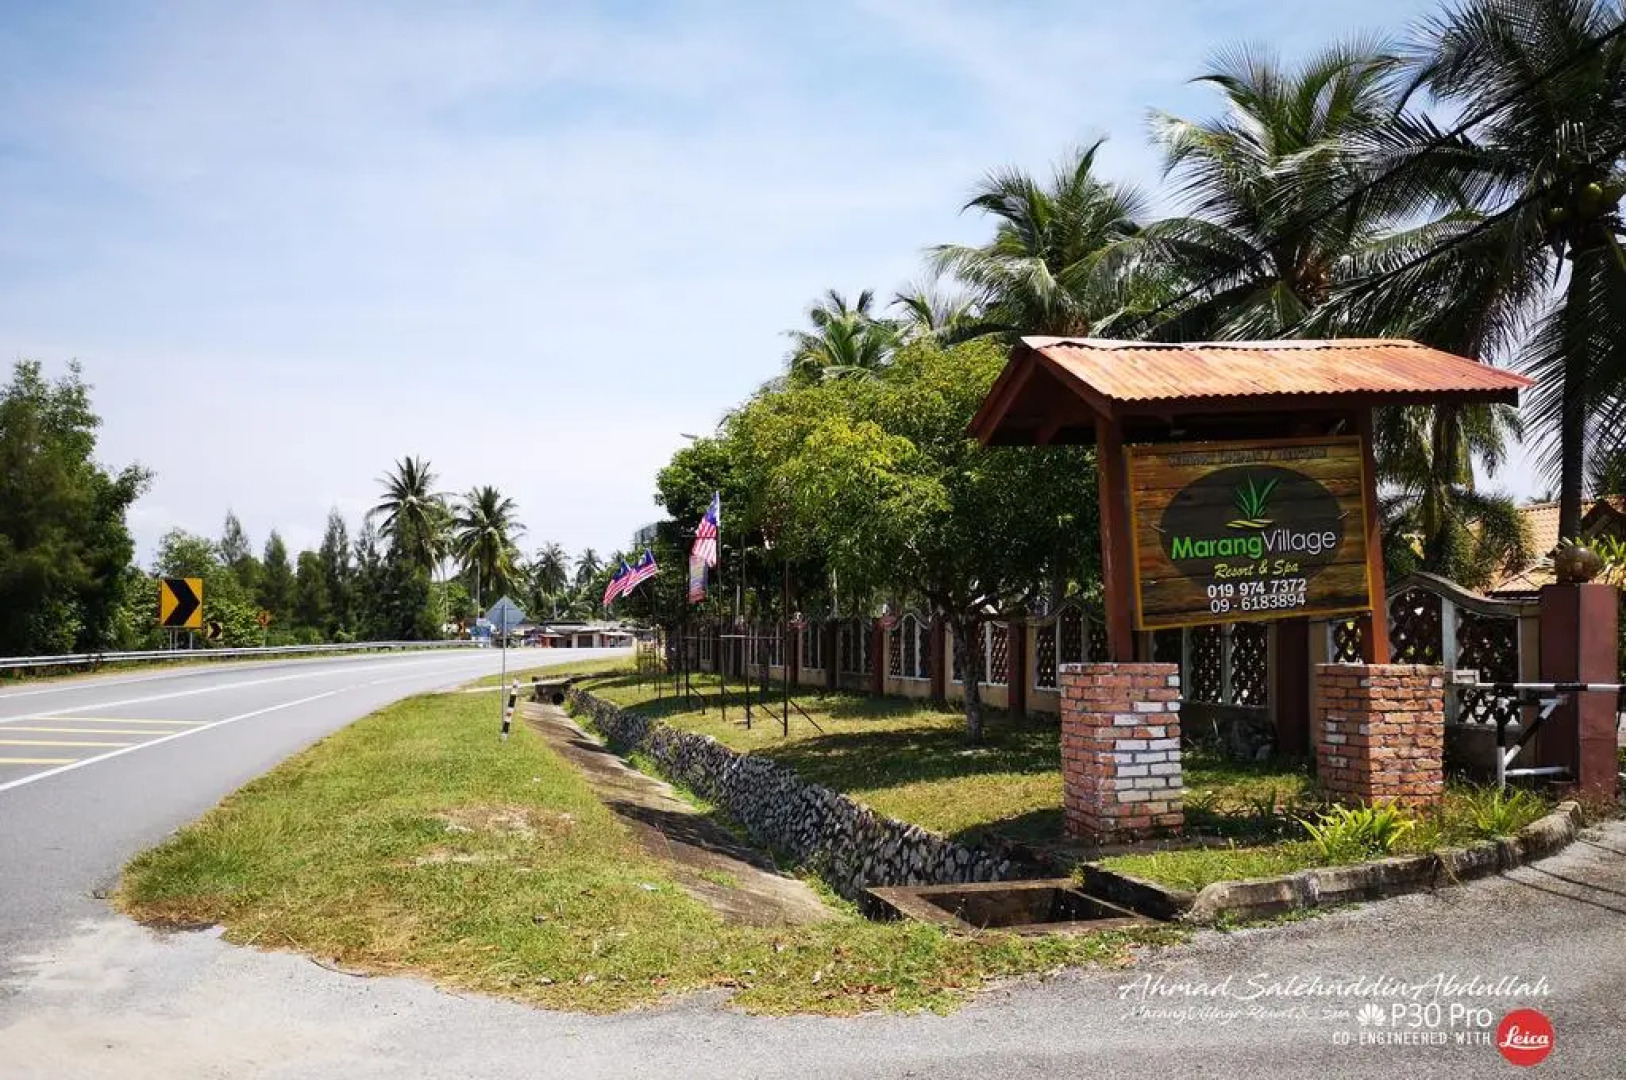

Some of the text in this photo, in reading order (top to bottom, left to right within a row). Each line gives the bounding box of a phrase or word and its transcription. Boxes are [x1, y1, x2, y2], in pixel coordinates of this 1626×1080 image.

[1171, 528, 1337, 560] MarangVillage
[1214, 559, 1299, 579] Resort & Spa
[1207, 578, 1308, 598] 019 974 7372
[1211, 598, 1230, 614] 09
[1241, 593, 1306, 611] 6183894
